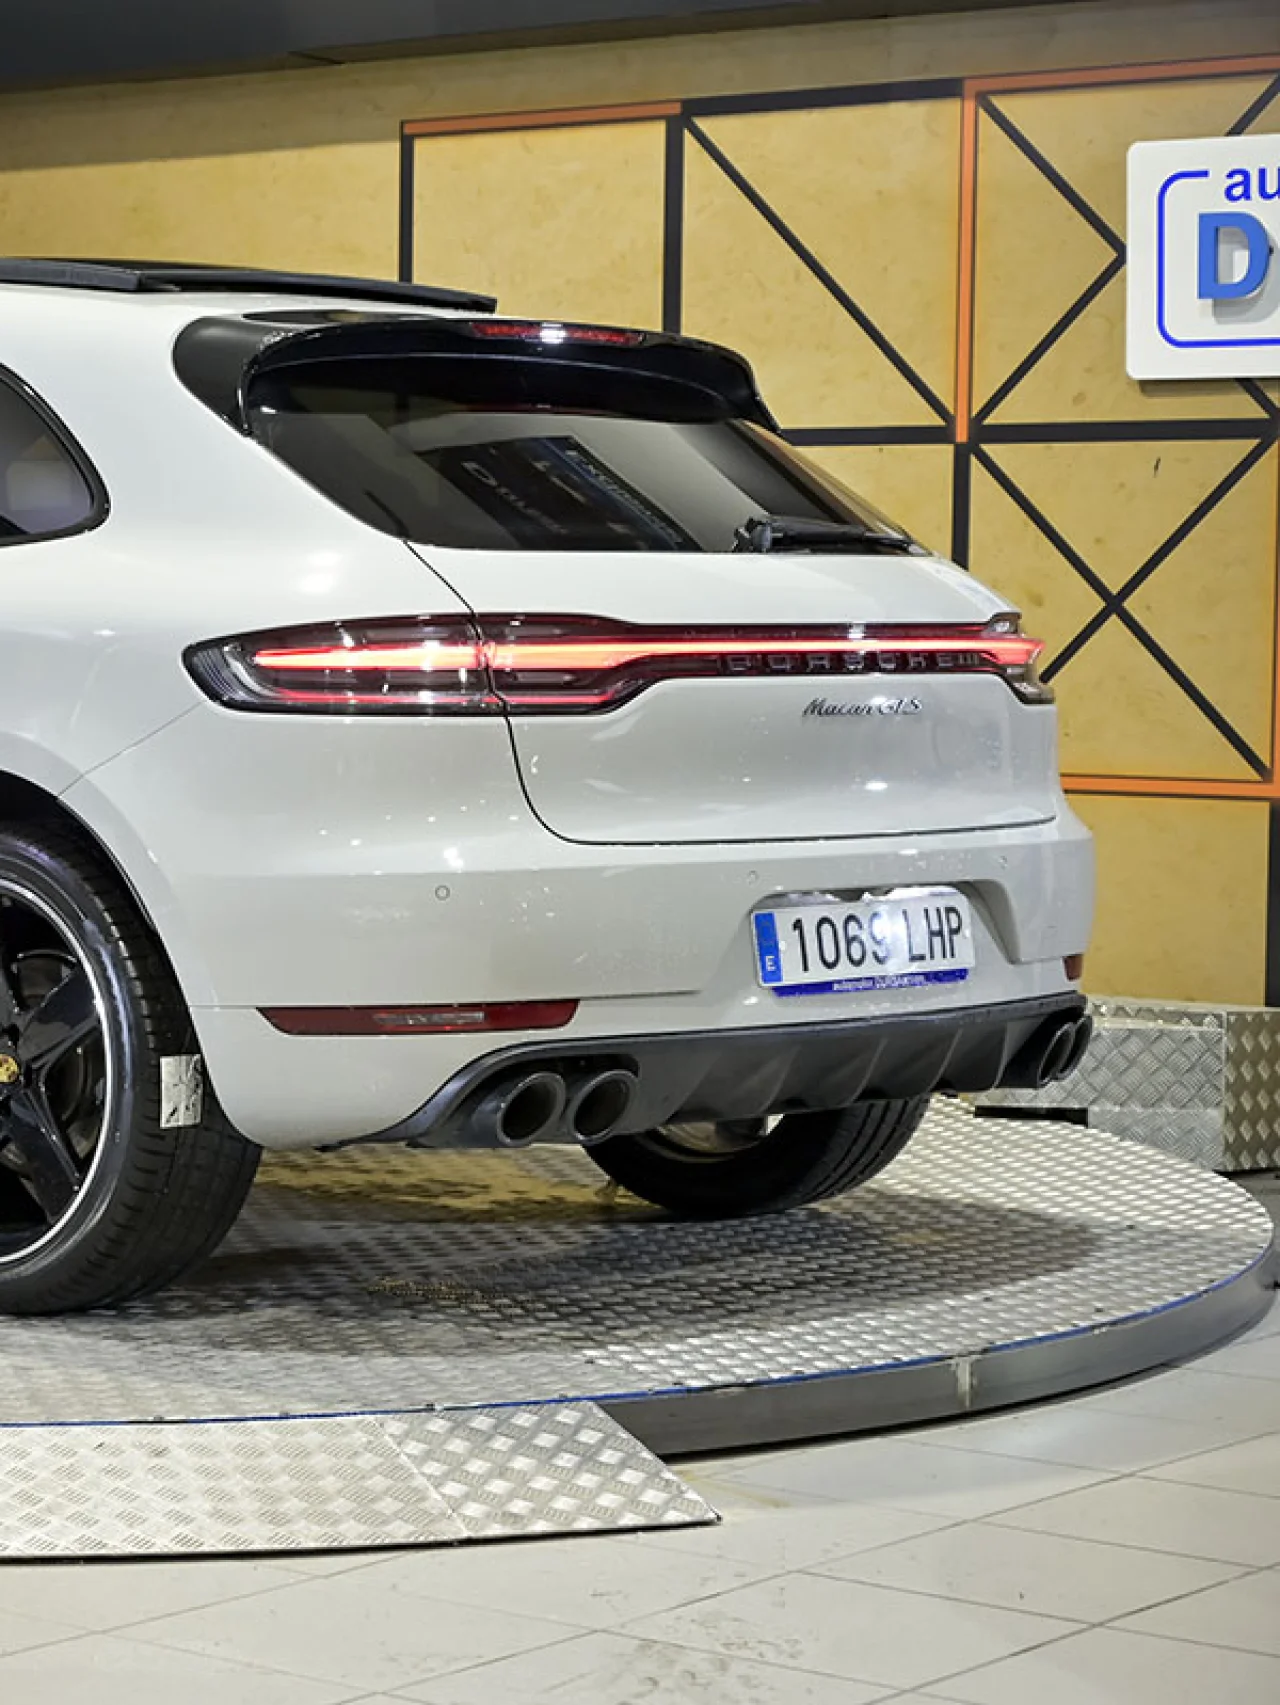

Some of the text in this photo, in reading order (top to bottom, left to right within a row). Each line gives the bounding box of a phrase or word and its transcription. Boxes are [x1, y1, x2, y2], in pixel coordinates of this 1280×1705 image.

[801, 697, 873, 717] Macan
[791, 905, 963, 974] 1069 LHP
